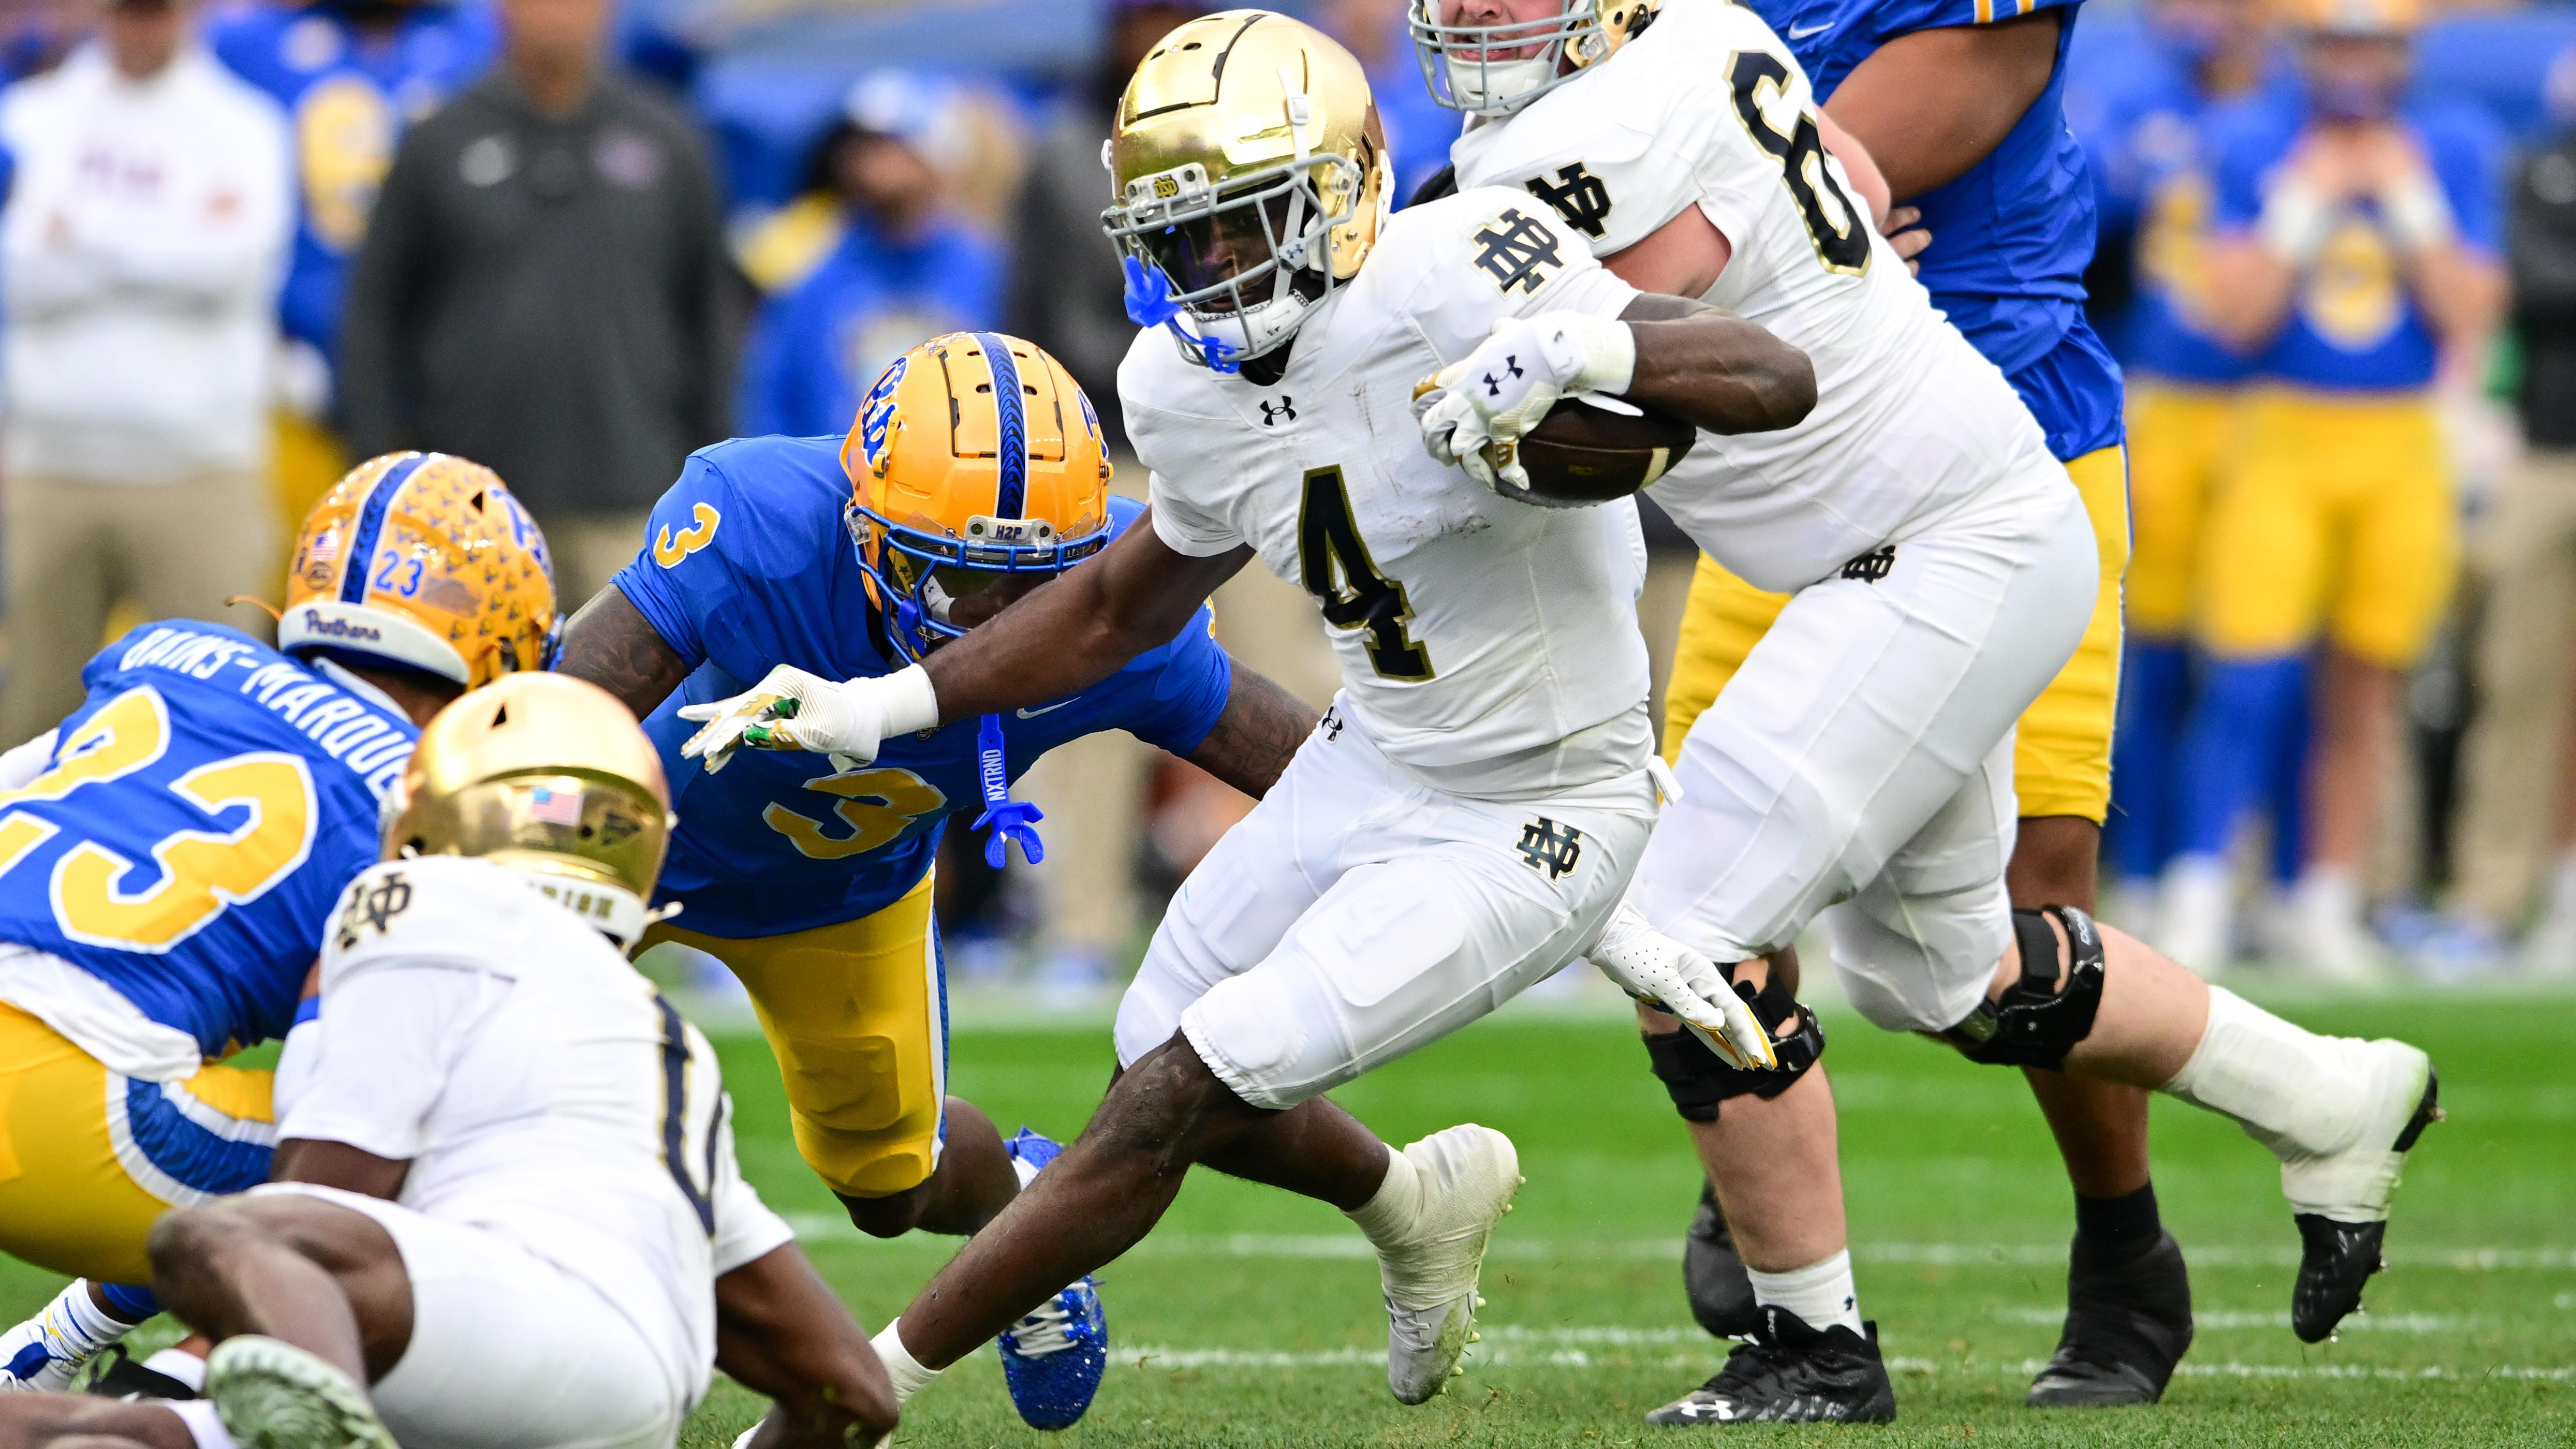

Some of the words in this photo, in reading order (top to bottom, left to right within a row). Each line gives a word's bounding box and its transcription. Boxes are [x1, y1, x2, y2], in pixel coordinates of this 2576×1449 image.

[653, 502, 720, 569] 3
[995, 524, 1023, 539] H2P
[374, 550, 424, 597] 23
[1298, 464, 1436, 682] 4
[305, 608, 381, 641] Panthers
[982, 749, 1007, 802] NXTRND
[0, 683, 319, 955] 23
[762, 767, 948, 860] 3
